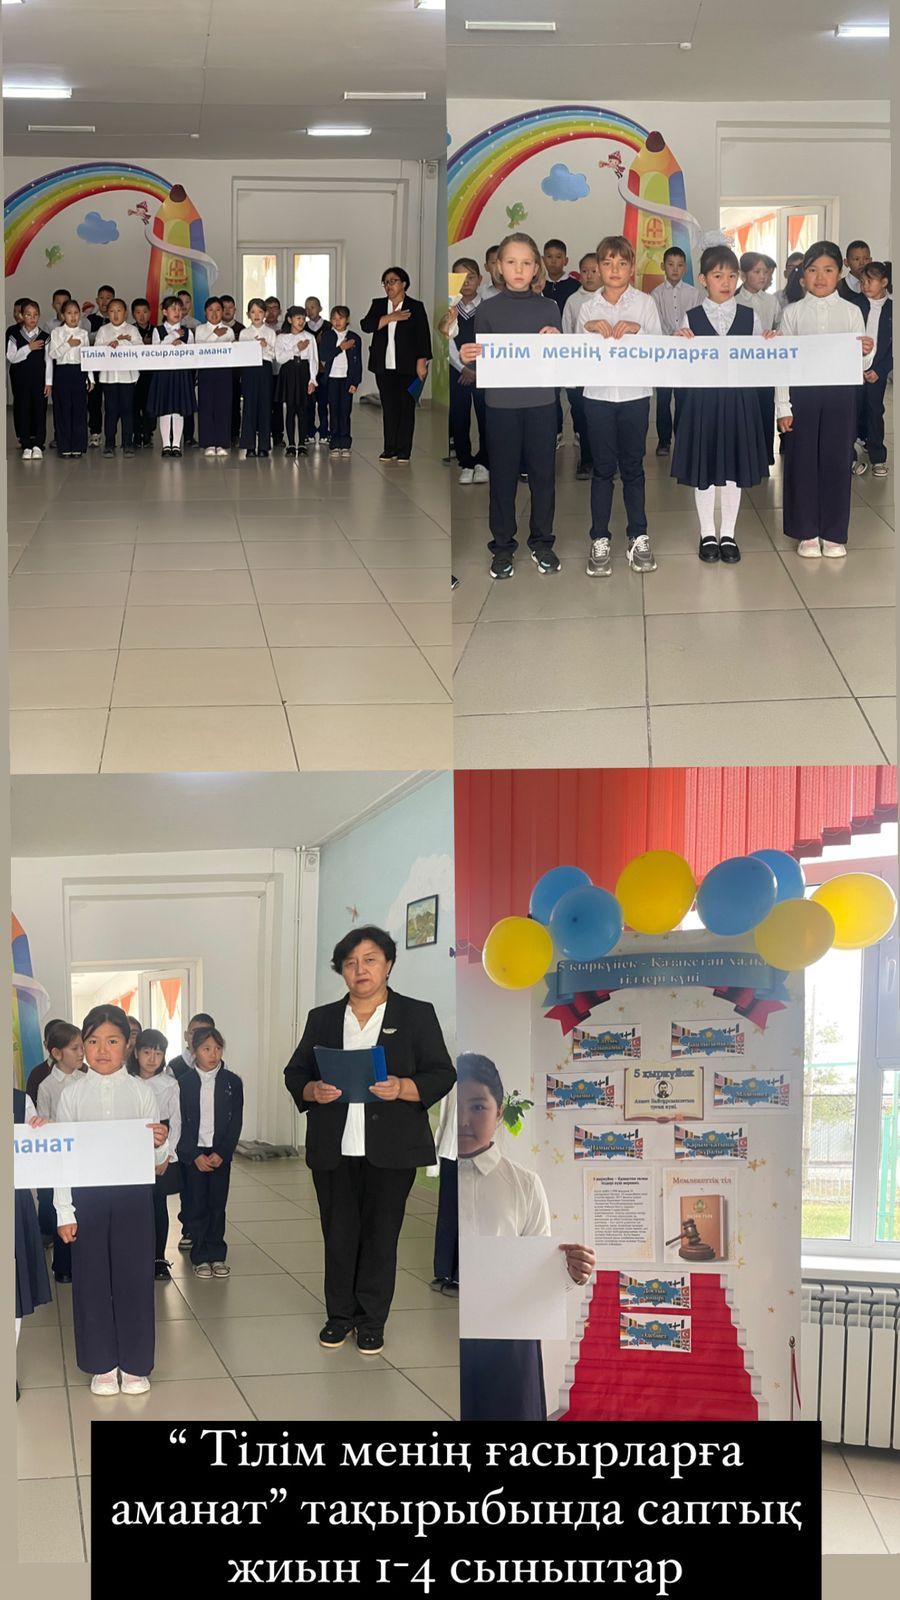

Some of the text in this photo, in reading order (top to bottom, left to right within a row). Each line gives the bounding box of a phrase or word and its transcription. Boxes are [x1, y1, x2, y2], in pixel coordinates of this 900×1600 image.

[81, 346, 233, 359] Тілім менің ғасырларға аманат
[481, 343, 799, 363] Тілім менің ғасырларға аманат
[633, 1068, 641, 1079] 5
